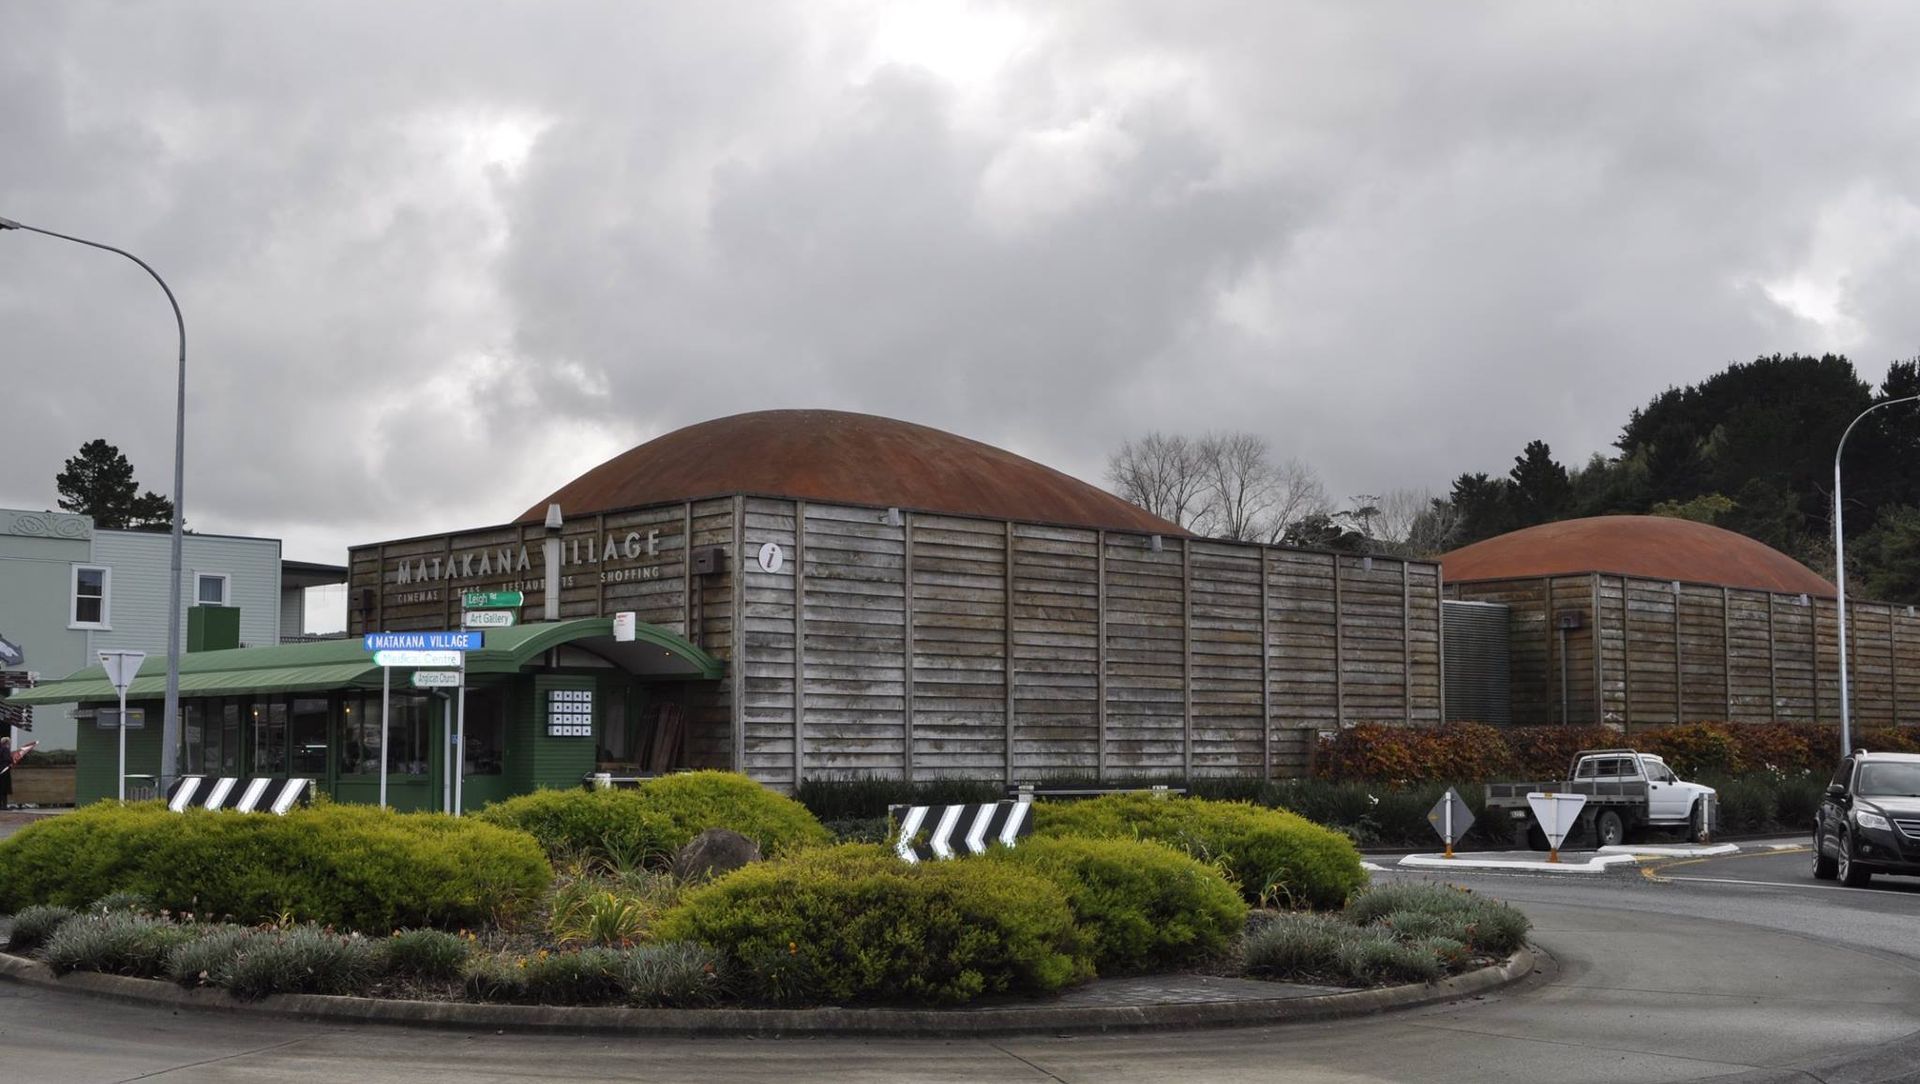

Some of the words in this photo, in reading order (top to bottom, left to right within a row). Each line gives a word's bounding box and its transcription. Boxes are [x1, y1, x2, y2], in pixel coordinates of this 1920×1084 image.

[397, 544, 531, 585] MATAKANA
[398, 590, 439, 604] CINEMAS
[600, 566, 660, 583] SHOPPING
[469, 593, 487, 606] Leigh
[490, 592, 498, 600] Rd
[470, 614, 483, 625] Art
[483, 613, 509, 625] Gallery
[376, 636, 425, 648] MATAKANA
[430, 635, 469, 647] VILLAGE
[418, 674, 439, 685] Anglican
[440, 673, 457, 684] Church
